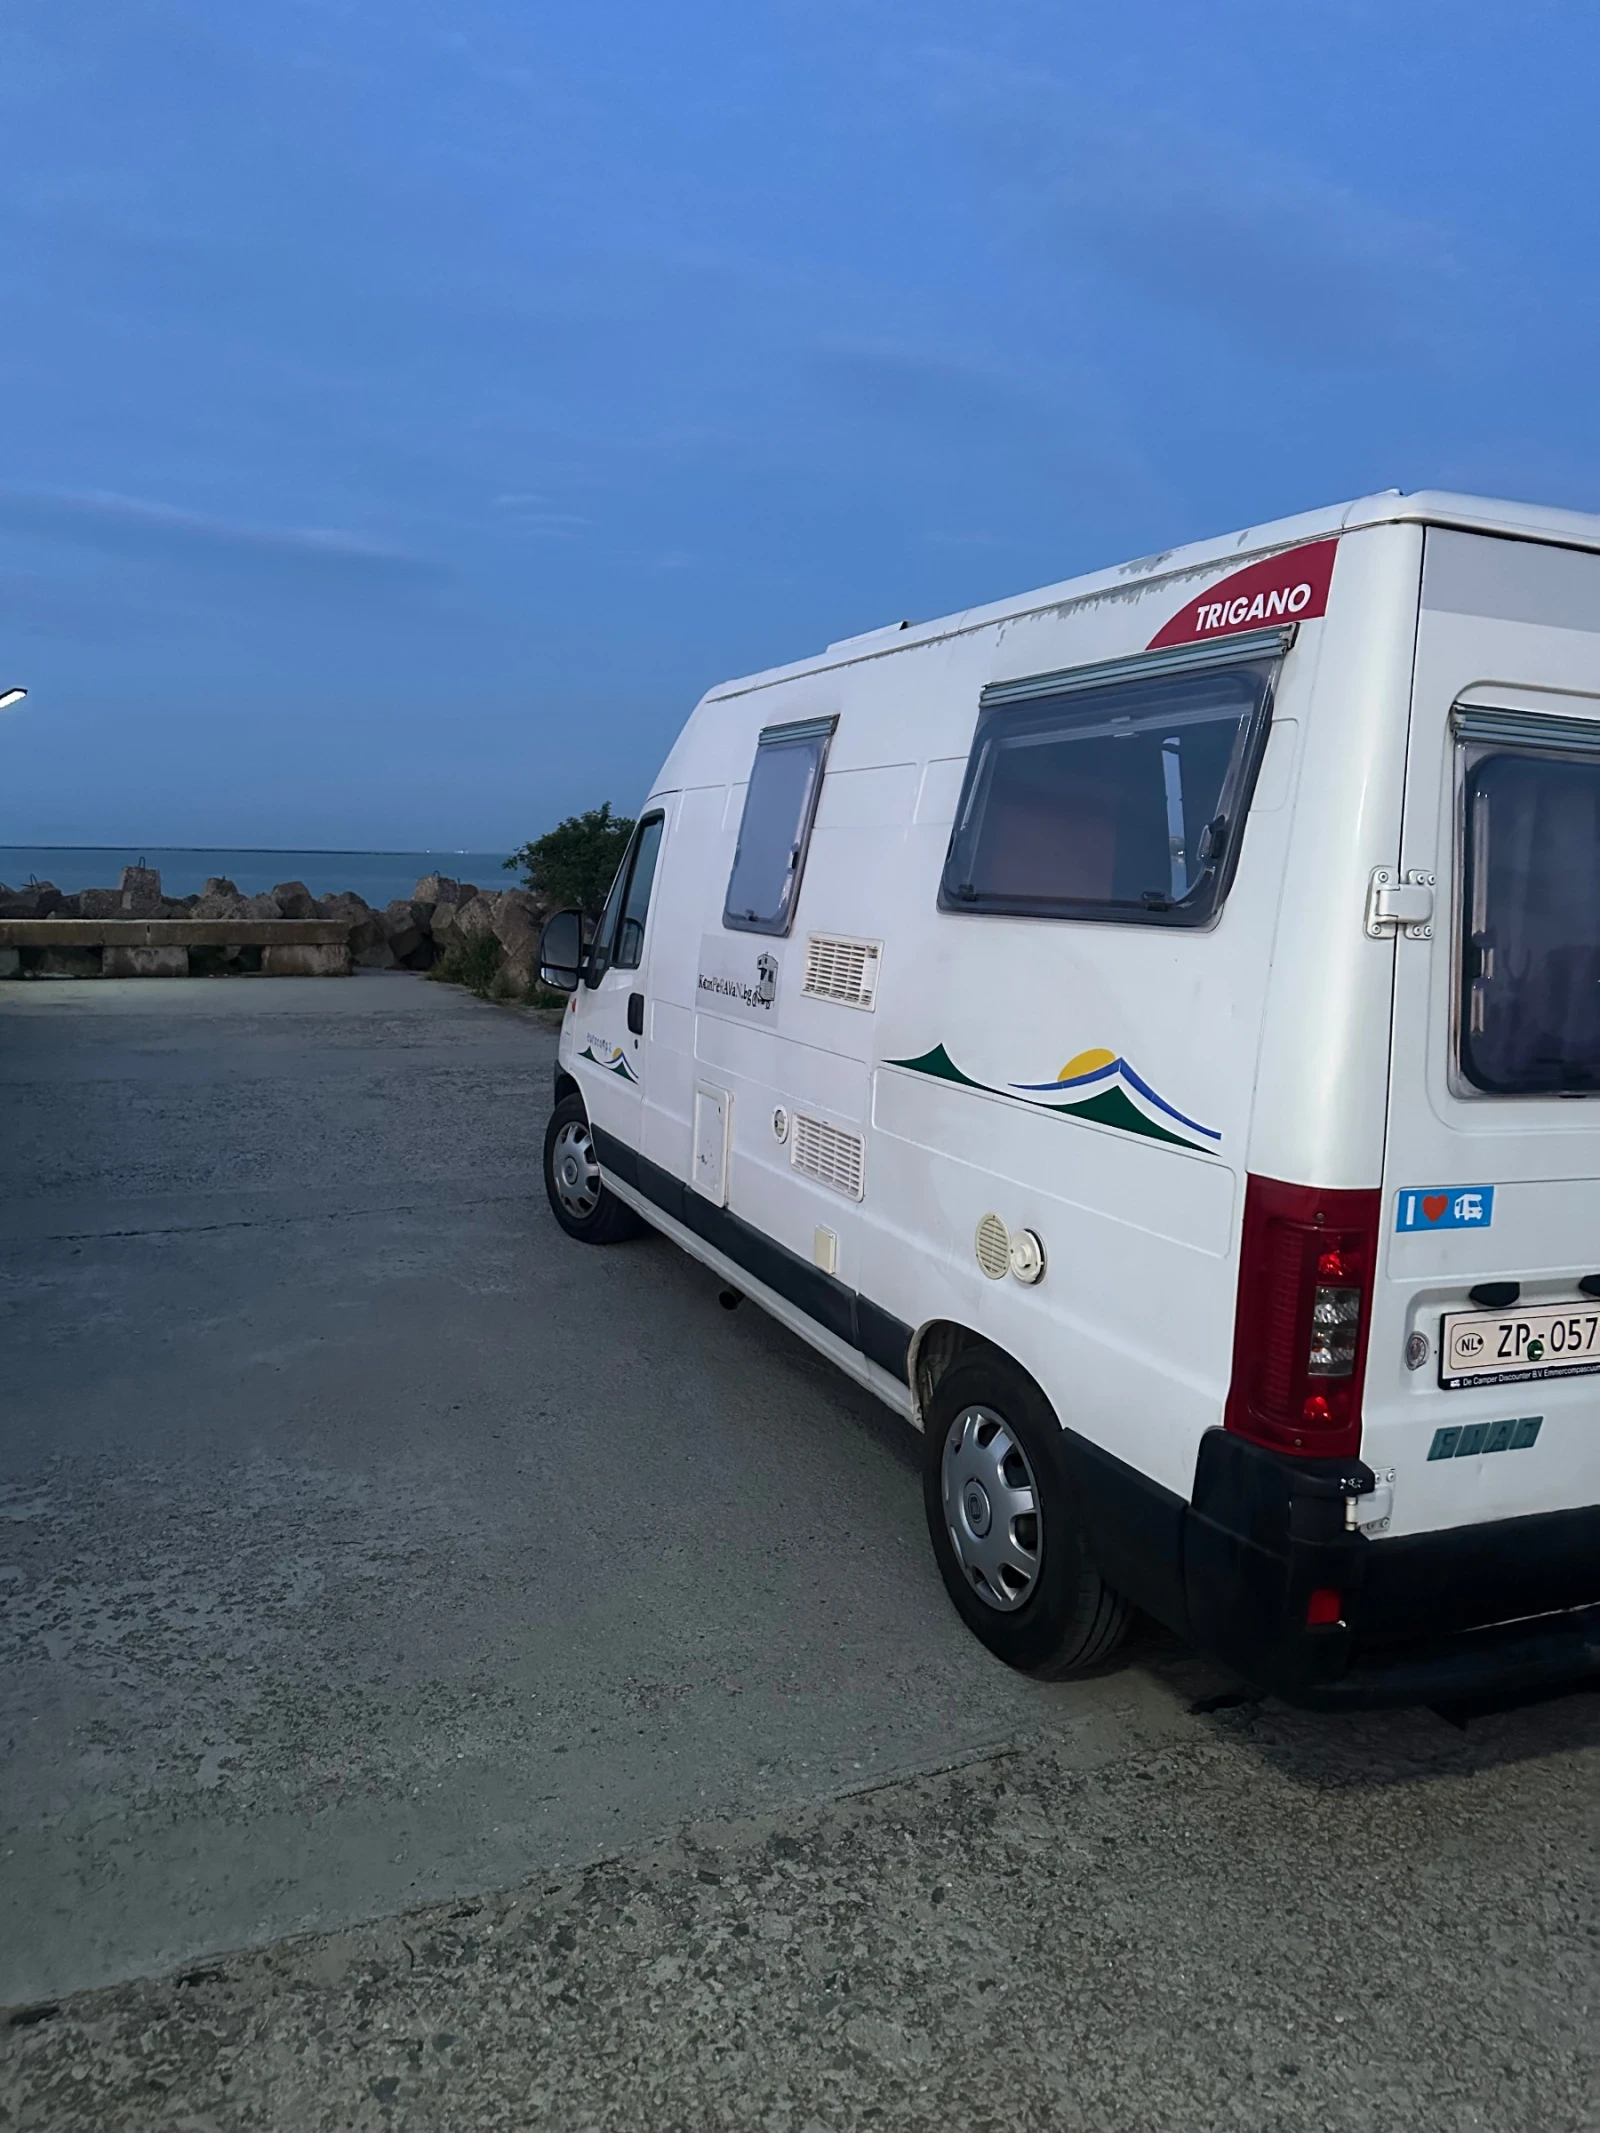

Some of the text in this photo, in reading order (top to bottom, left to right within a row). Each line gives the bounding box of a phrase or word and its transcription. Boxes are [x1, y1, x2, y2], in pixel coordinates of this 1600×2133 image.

[1195, 583, 1312, 632] TRIGANO
[1405, 1195, 1416, 1226] I
[1461, 1338, 1479, 1352] NL
[1463, 1378, 1472, 1387] De
[1473, 1376, 1498, 1386] Camper
[1498, 1371, 1532, 1383] Discounter
[1430, 1418, 1541, 1459] FIAT
